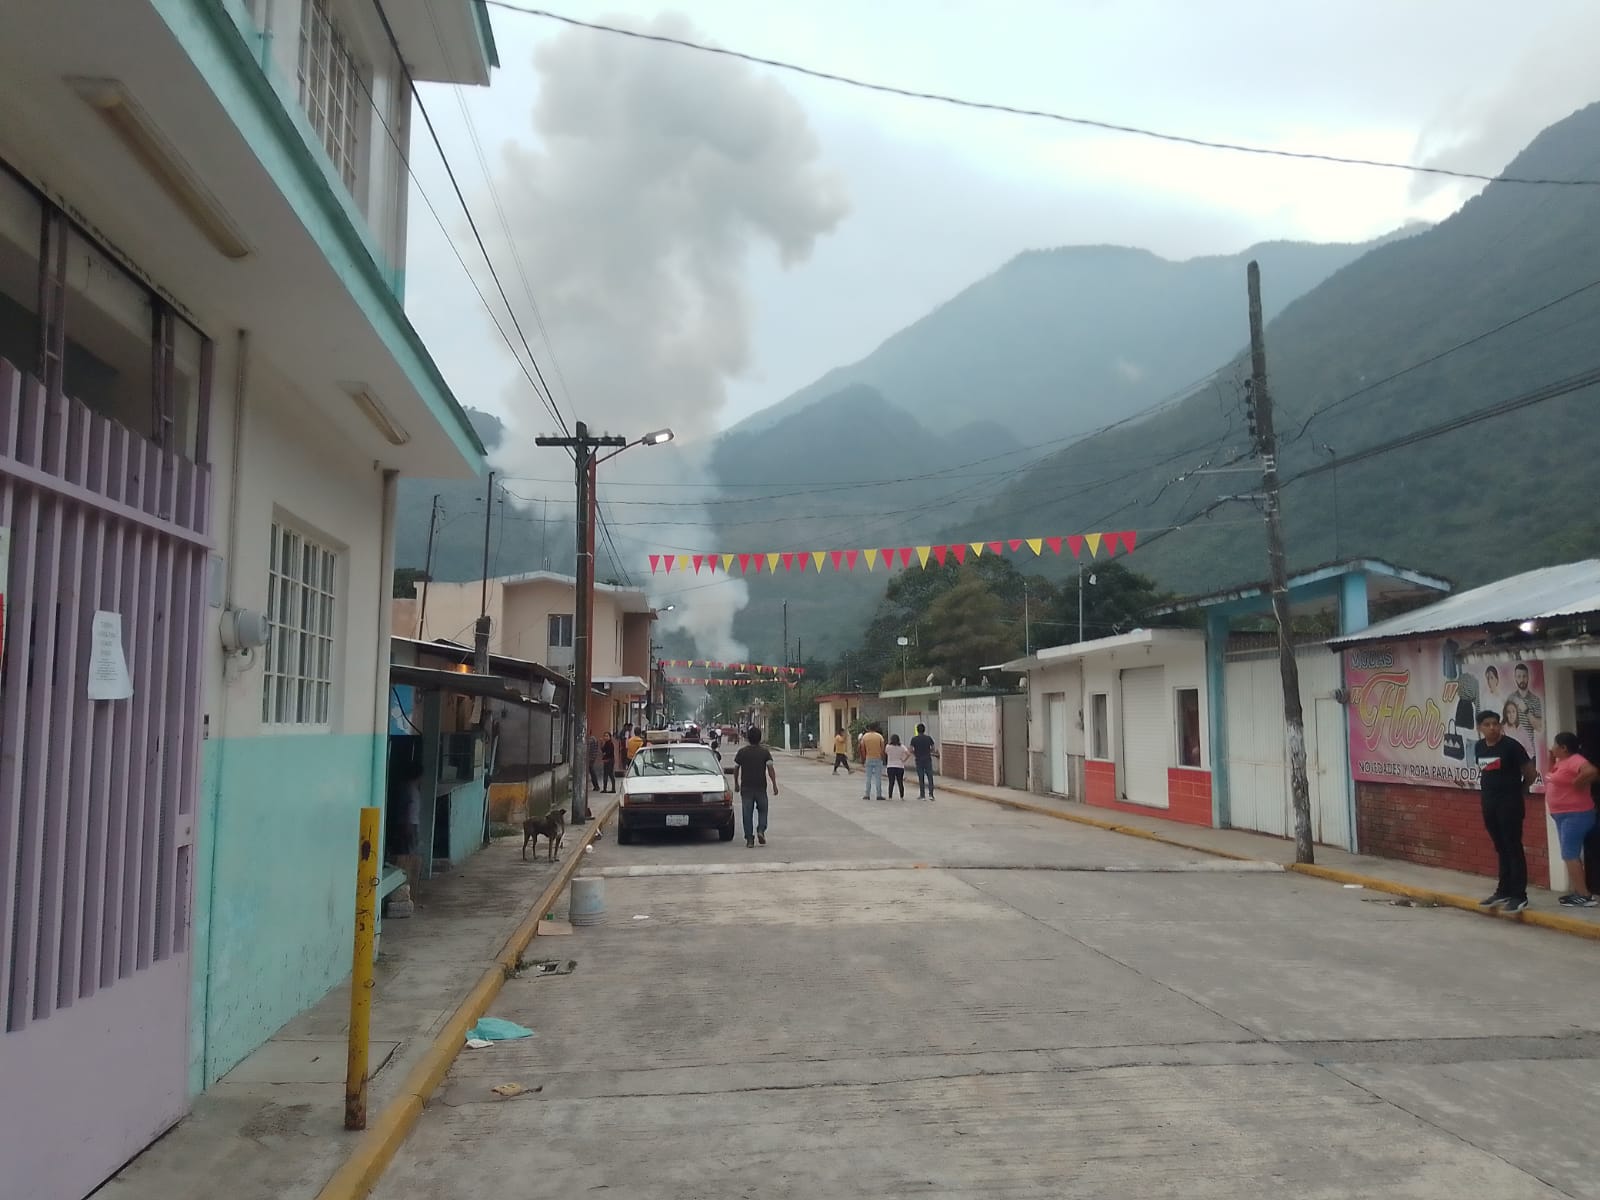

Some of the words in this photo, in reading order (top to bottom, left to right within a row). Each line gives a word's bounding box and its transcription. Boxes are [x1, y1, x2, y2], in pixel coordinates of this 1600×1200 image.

[1359, 761, 1401, 776] NOVEDADES
[1410, 764, 1430, 777] ROPA
[1432, 766, 1454, 779] PARA
